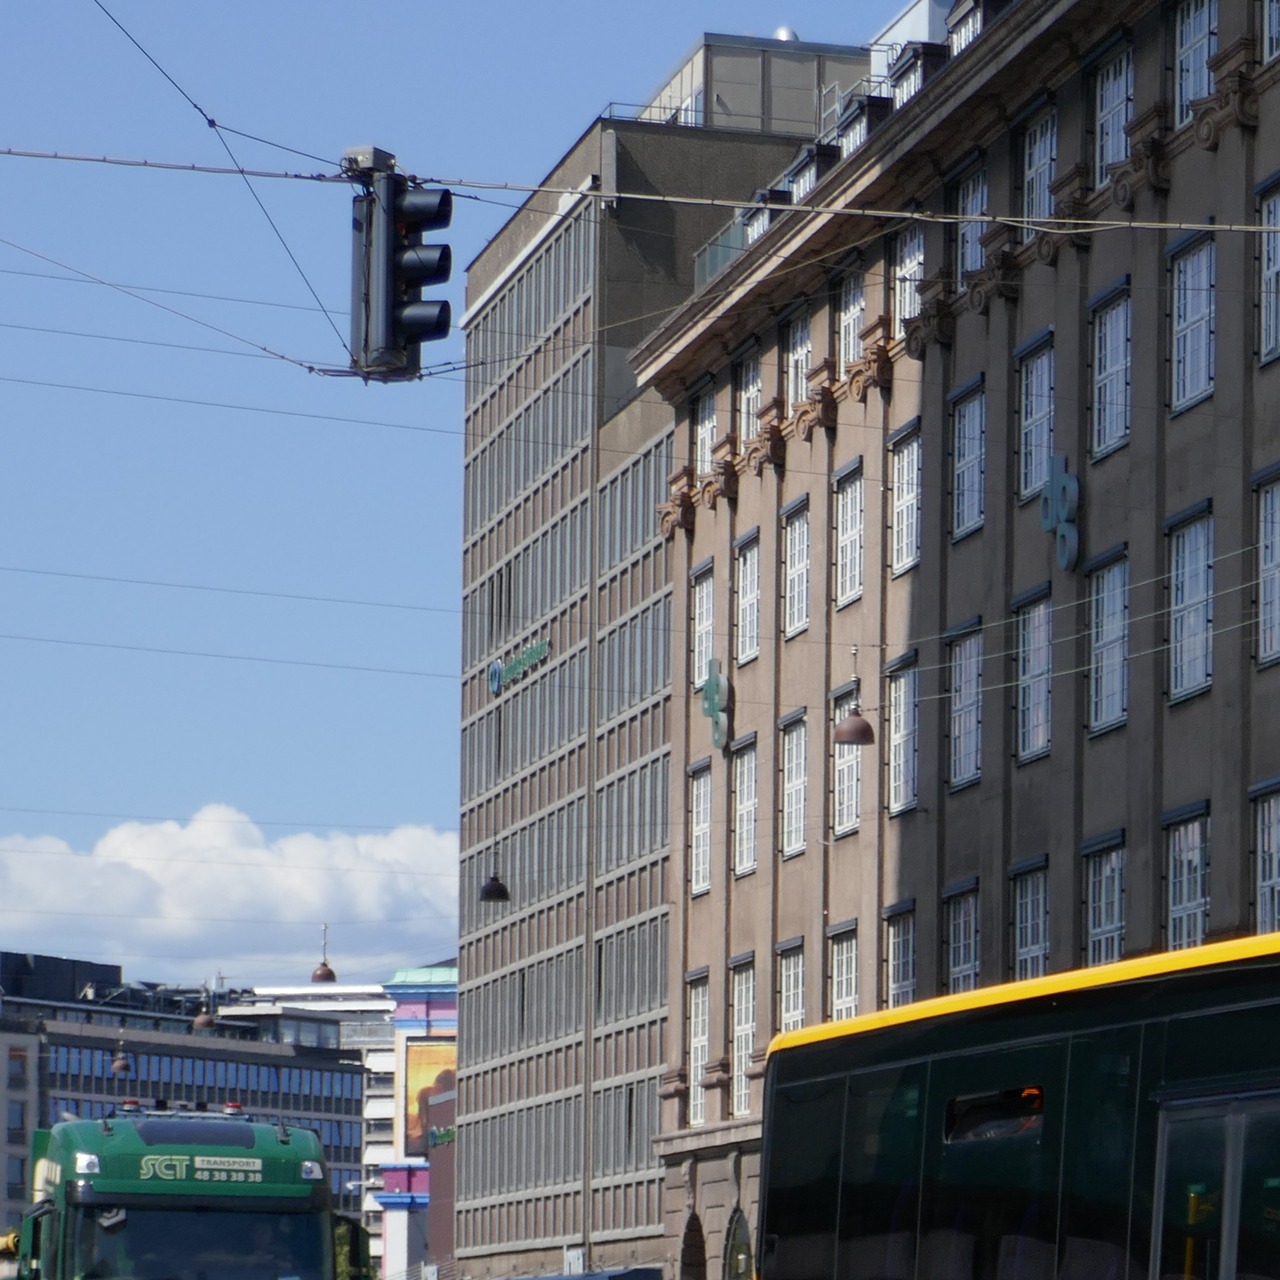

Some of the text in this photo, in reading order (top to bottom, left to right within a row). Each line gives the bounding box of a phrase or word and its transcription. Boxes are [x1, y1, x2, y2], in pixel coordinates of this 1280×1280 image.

[140, 1155, 190, 1180] SCT
[200, 1159, 257, 1168] TRANSPORT
[194, 1170, 210, 1180] 48
[213, 1171, 227, 1181] 38
[230, 1171, 245, 1182] 38
